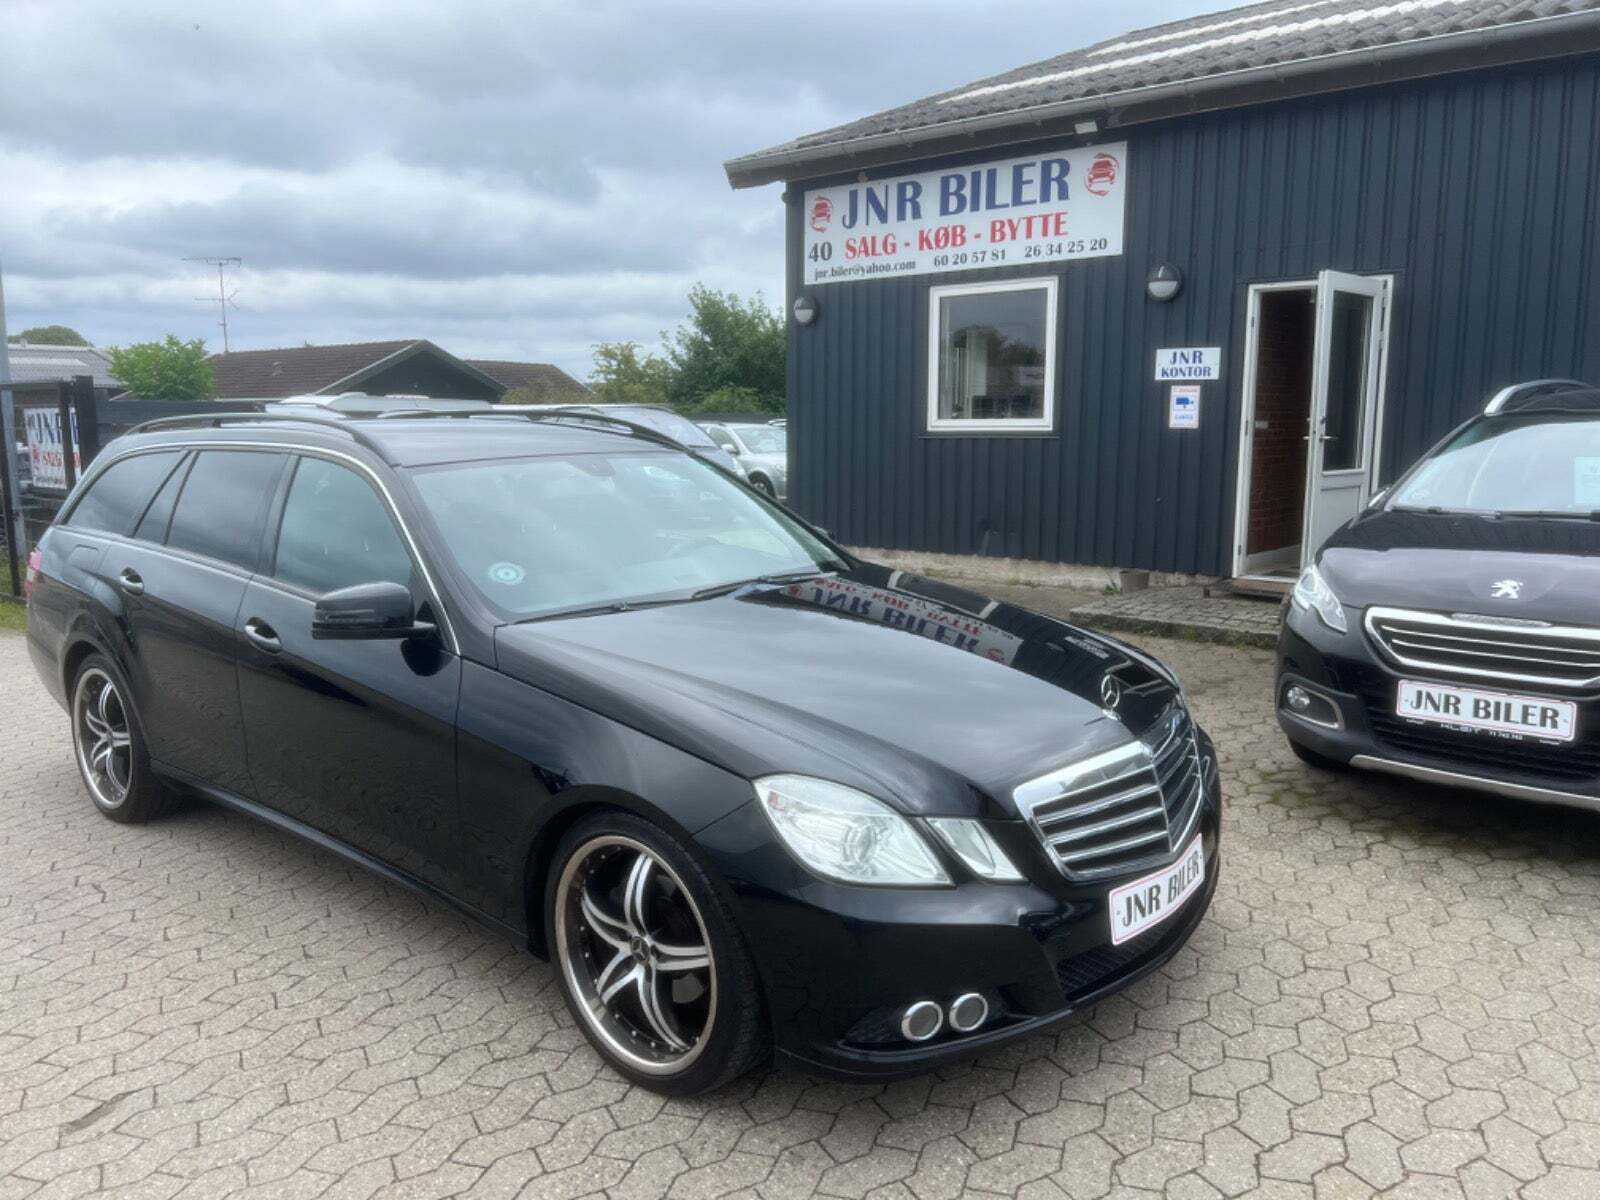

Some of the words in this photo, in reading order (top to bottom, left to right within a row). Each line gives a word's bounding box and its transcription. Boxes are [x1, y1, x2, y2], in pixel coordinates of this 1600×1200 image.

[842, 180, 922, 229] JNR
[939, 158, 1071, 216] BILER
[845, 233, 896, 259] SALG
[918, 224, 967, 251] KØB
[990, 211, 1069, 243] BYTTE
[808, 241, 832, 262] 40
[934, 255, 949, 267] 60
[952, 253, 968, 265] 20
[971, 251, 987, 263] 57
[991, 249, 1006, 261] 81
[1024, 245, 1041, 258] 26
[1045, 242, 1062, 256] 34
[1067, 240, 1085, 253] 25
[1090, 237, 1108, 251] 20
[1170, 350, 1203, 364] JNR
[1161, 366, 1211, 377] KONTOR
[1410, 689, 1461, 715] JNR
[1472, 698, 1560, 729] BILER
[1122, 884, 1161, 927] JNR
[1168, 850, 1199, 904] BILER
